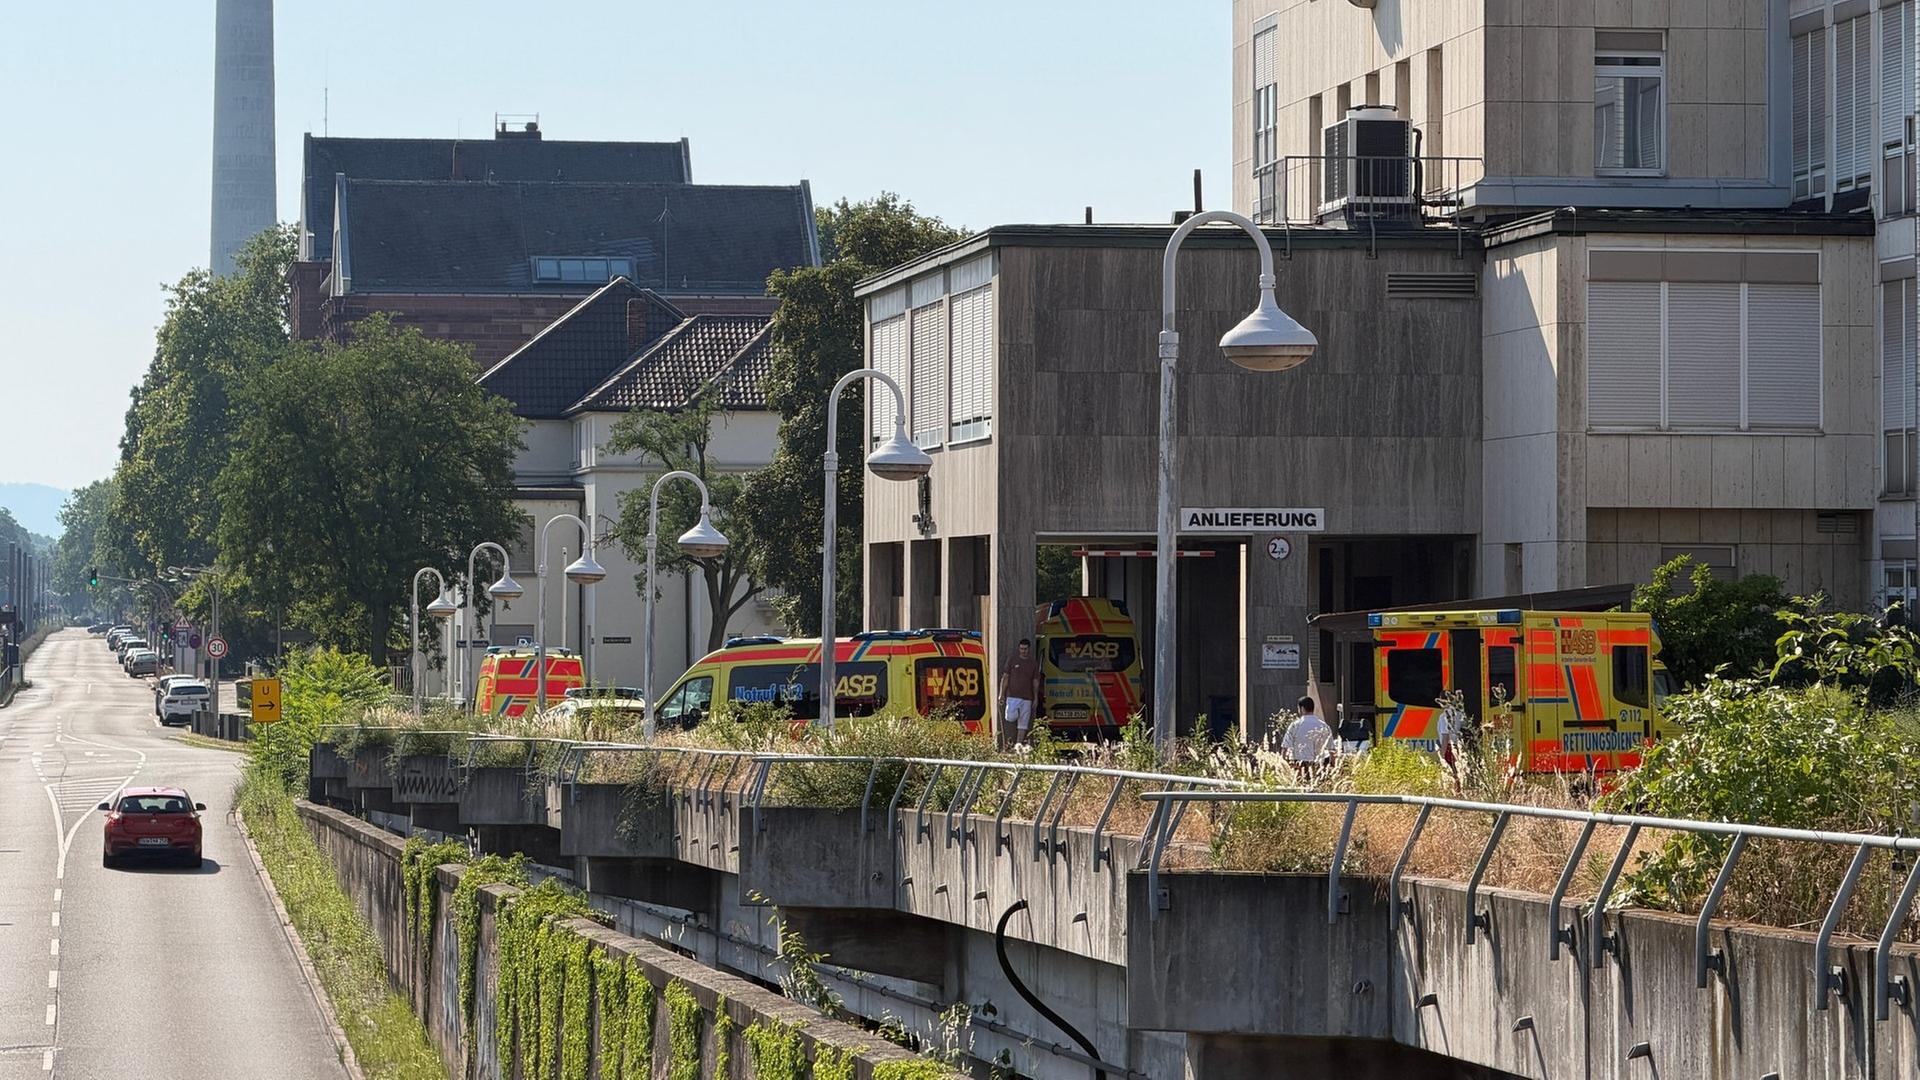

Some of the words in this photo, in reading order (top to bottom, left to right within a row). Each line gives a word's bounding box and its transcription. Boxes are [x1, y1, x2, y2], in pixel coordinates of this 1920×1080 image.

[1188, 512, 1317, 527] ANLIEFERUNG
[211, 643, 223, 653] 30
[1080, 641, 1120, 659] ASB
[1570, 629, 1596, 655] ASB
[262, 685, 270, 696] U
[834, 674, 878, 697] ASB
[941, 667, 979, 697] ASB
[735, 683, 777, 701] Notruf
[1629, 709, 1642, 722] 112
[1563, 731, 1643, 752] RETTUNGSDIENST
